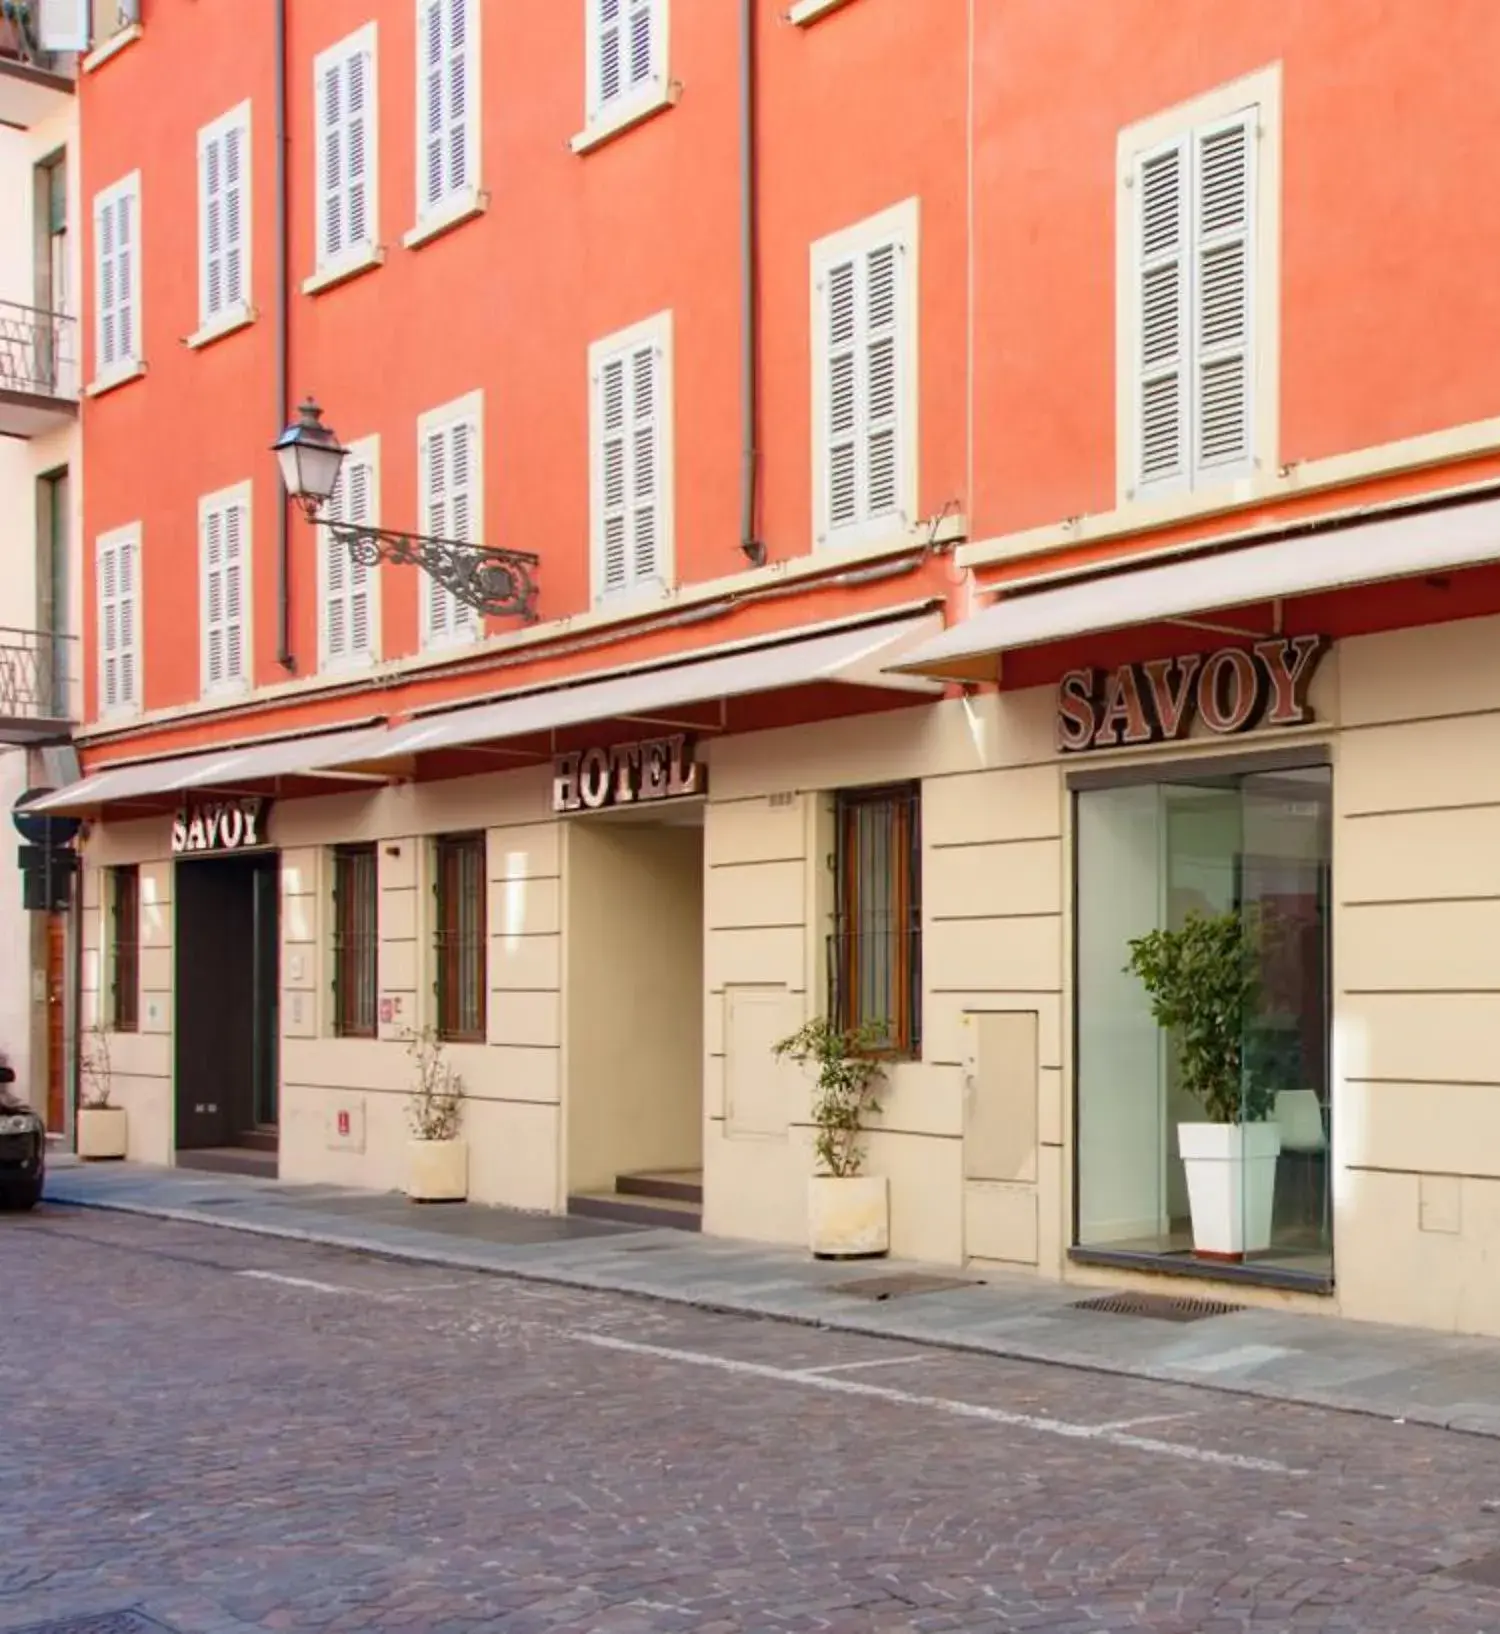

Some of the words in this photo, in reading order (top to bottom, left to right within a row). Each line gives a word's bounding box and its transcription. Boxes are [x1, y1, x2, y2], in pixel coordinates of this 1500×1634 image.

[1057, 634, 1321, 751] SAVOY
[552, 733, 697, 811] HOTEL
[171, 798, 263, 853] SAVOY
